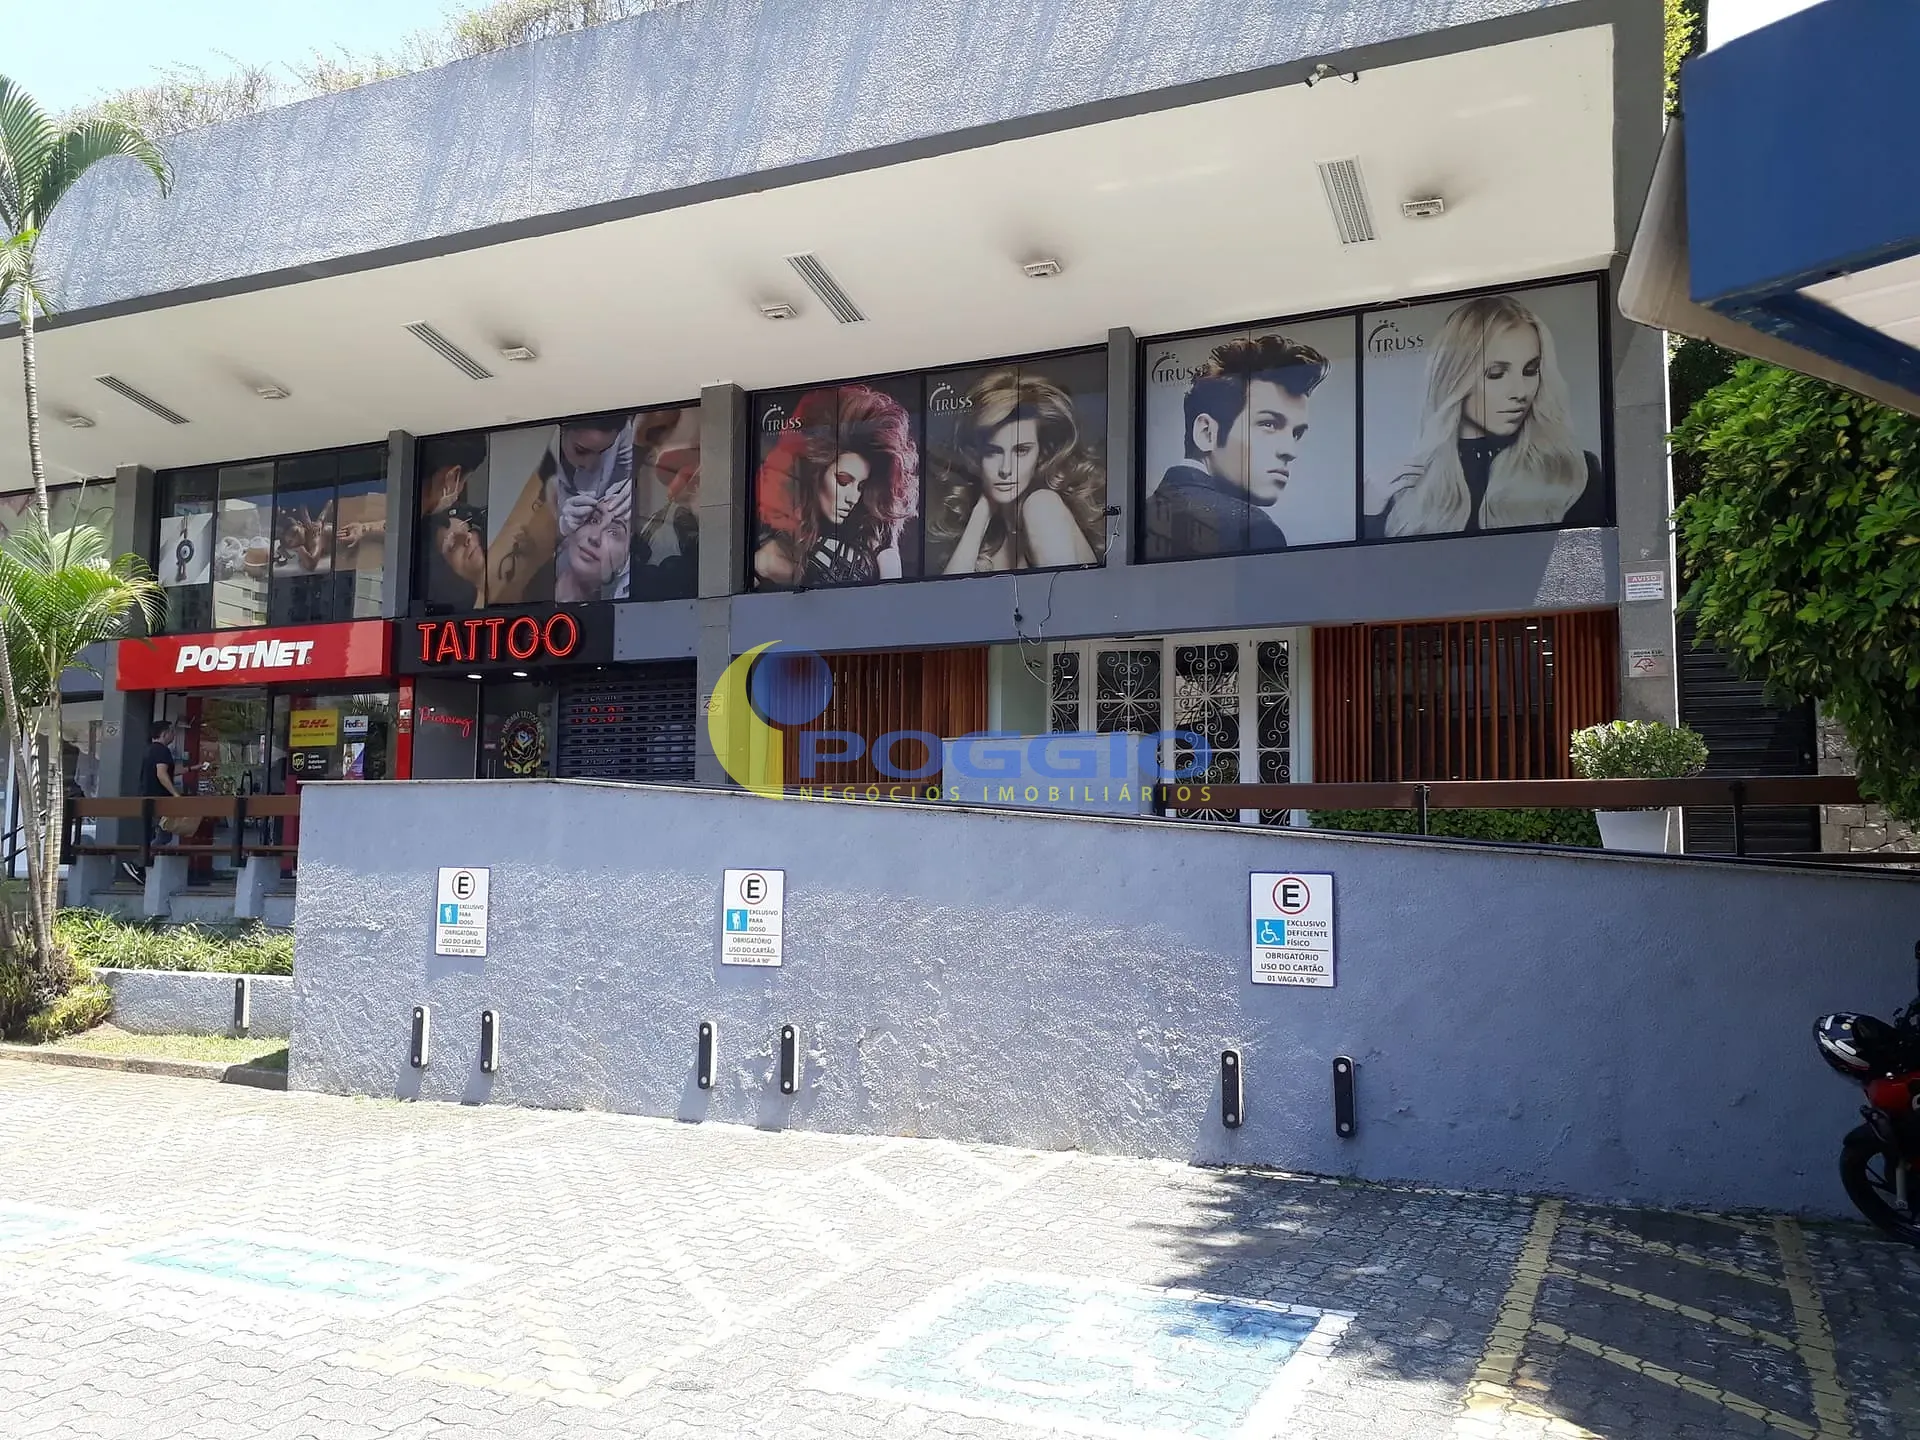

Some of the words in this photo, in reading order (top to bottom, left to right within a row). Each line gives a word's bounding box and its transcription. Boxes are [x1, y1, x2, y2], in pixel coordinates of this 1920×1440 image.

[1375, 335, 1424, 352] TRUSS
[936, 396, 972, 411] TRUSS
[768, 416, 801, 431] TRUSS
[1632, 575, 1657, 583] AVISO
[418, 612, 577, 662] TATTOO
[298, 718, 329, 729] DHL
[344, 720, 365, 728] FedEx
[418, 706, 473, 738] Piercing
[458, 876, 469, 894] E
[747, 879, 760, 898] E
[1282, 884, 1300, 907] E
[732, 937, 772, 945] OBRIGATÓRIO
[752, 946, 775, 954] CARTÃO
[1265, 952, 1319, 961] OBRIGATÓRIO
[1292, 964, 1324, 972] CARTÃO
